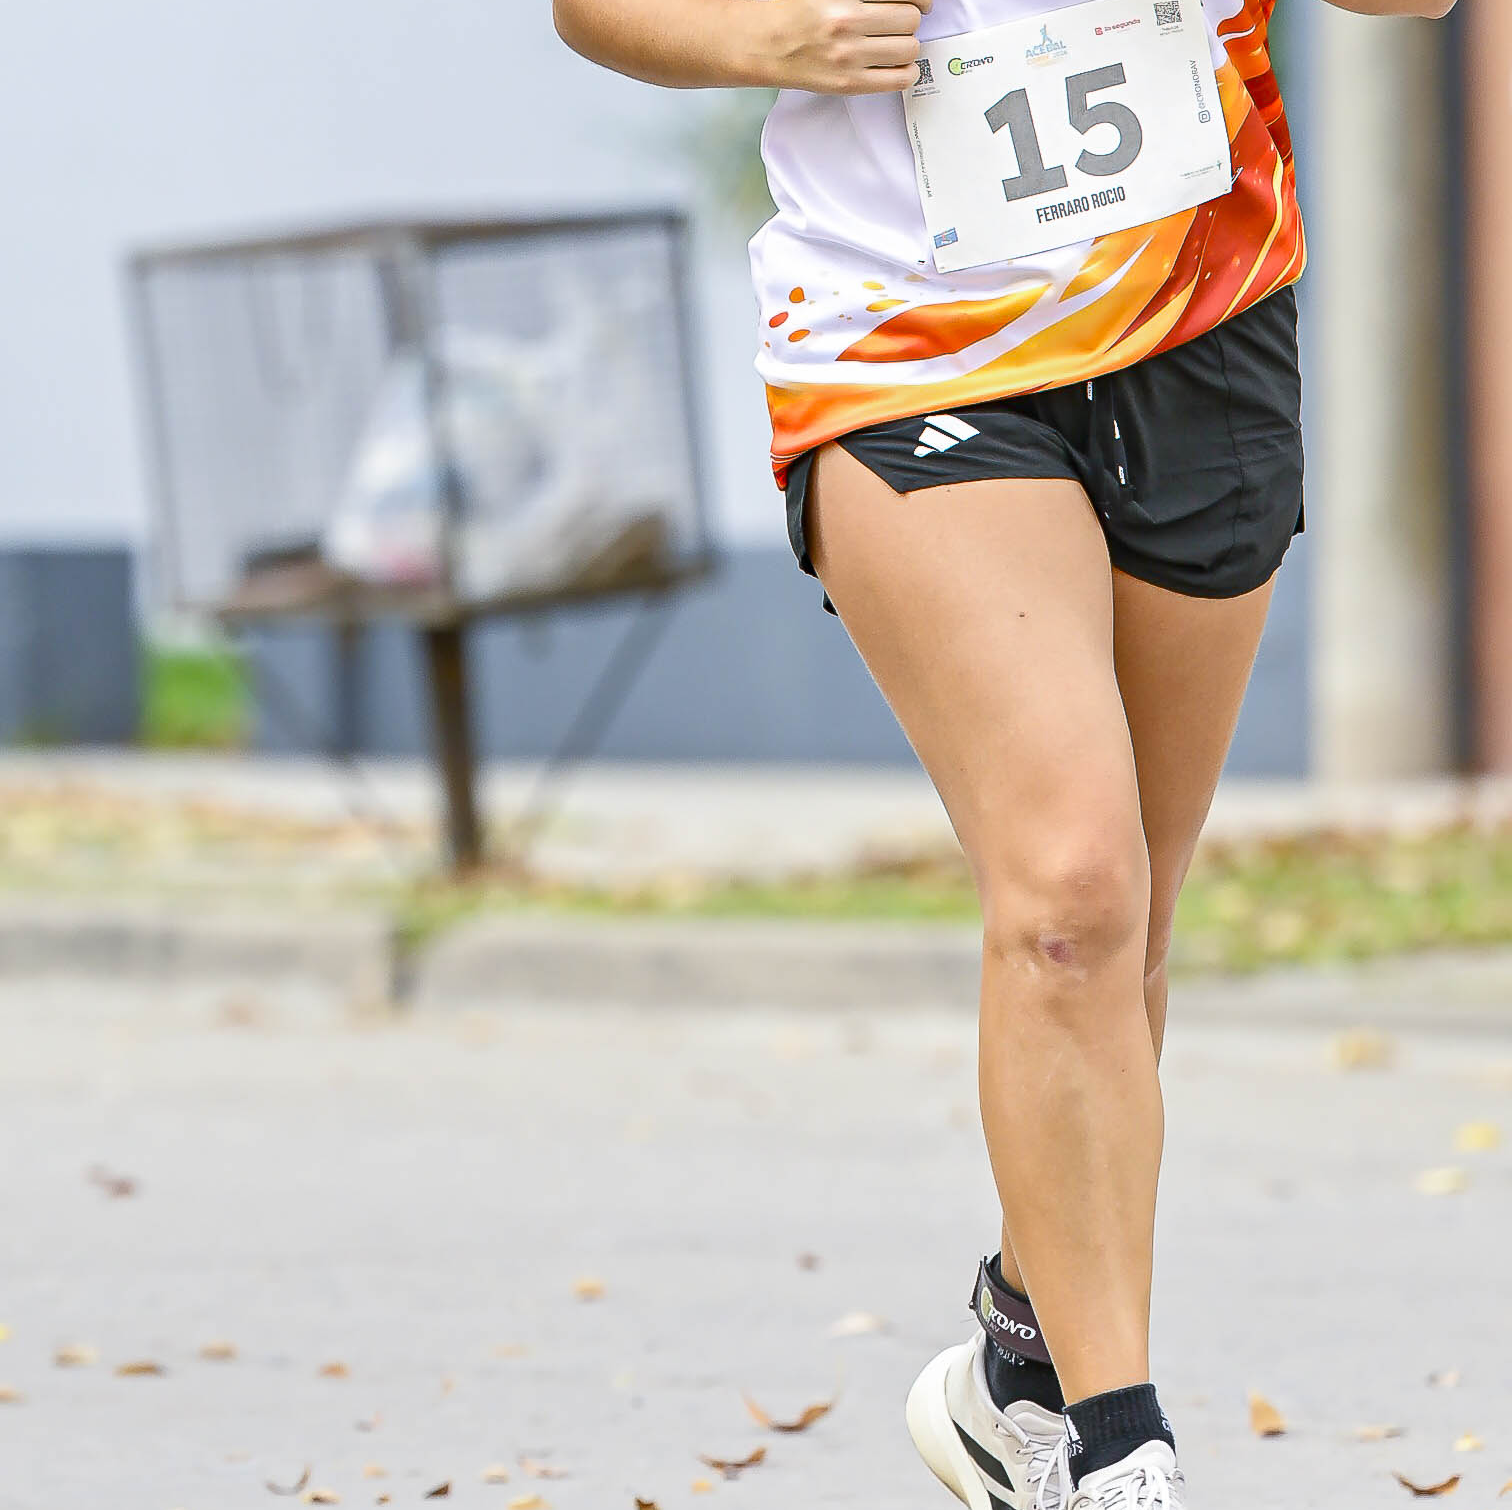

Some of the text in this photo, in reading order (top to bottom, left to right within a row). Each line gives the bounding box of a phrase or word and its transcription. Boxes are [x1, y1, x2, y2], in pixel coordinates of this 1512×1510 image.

[983, 62, 1143, 202] 15
[1036, 186, 1126, 224] FERRARO ROCIO
